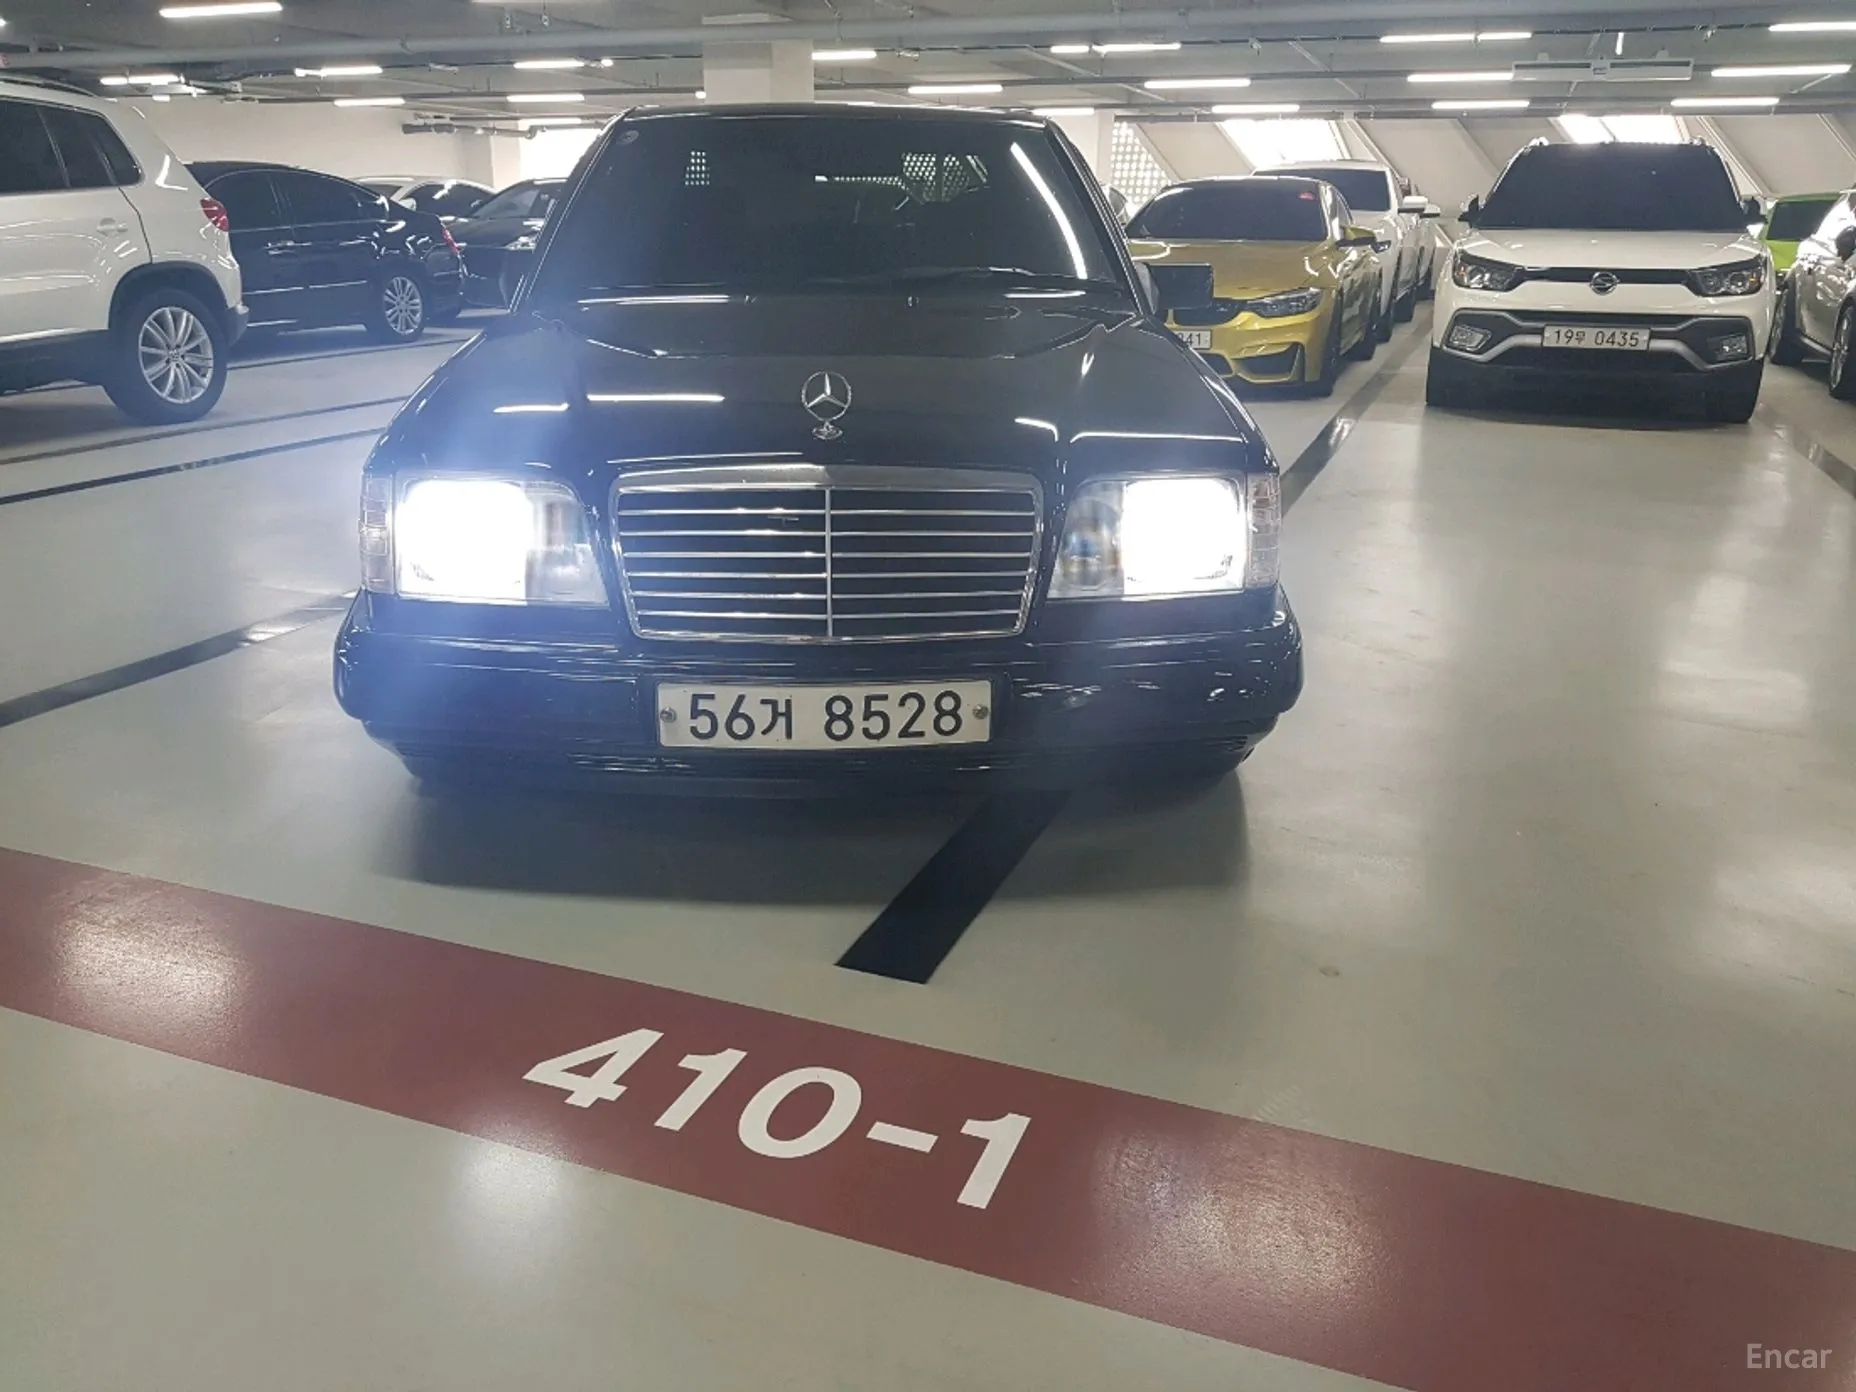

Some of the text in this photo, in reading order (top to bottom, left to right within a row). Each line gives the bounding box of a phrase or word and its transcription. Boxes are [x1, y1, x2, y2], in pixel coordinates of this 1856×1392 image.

[1594, 330, 1640, 347] 0435
[689, 689, 963, 742] 56거 8528
[521, 1028, 1032, 1210] 410-1
